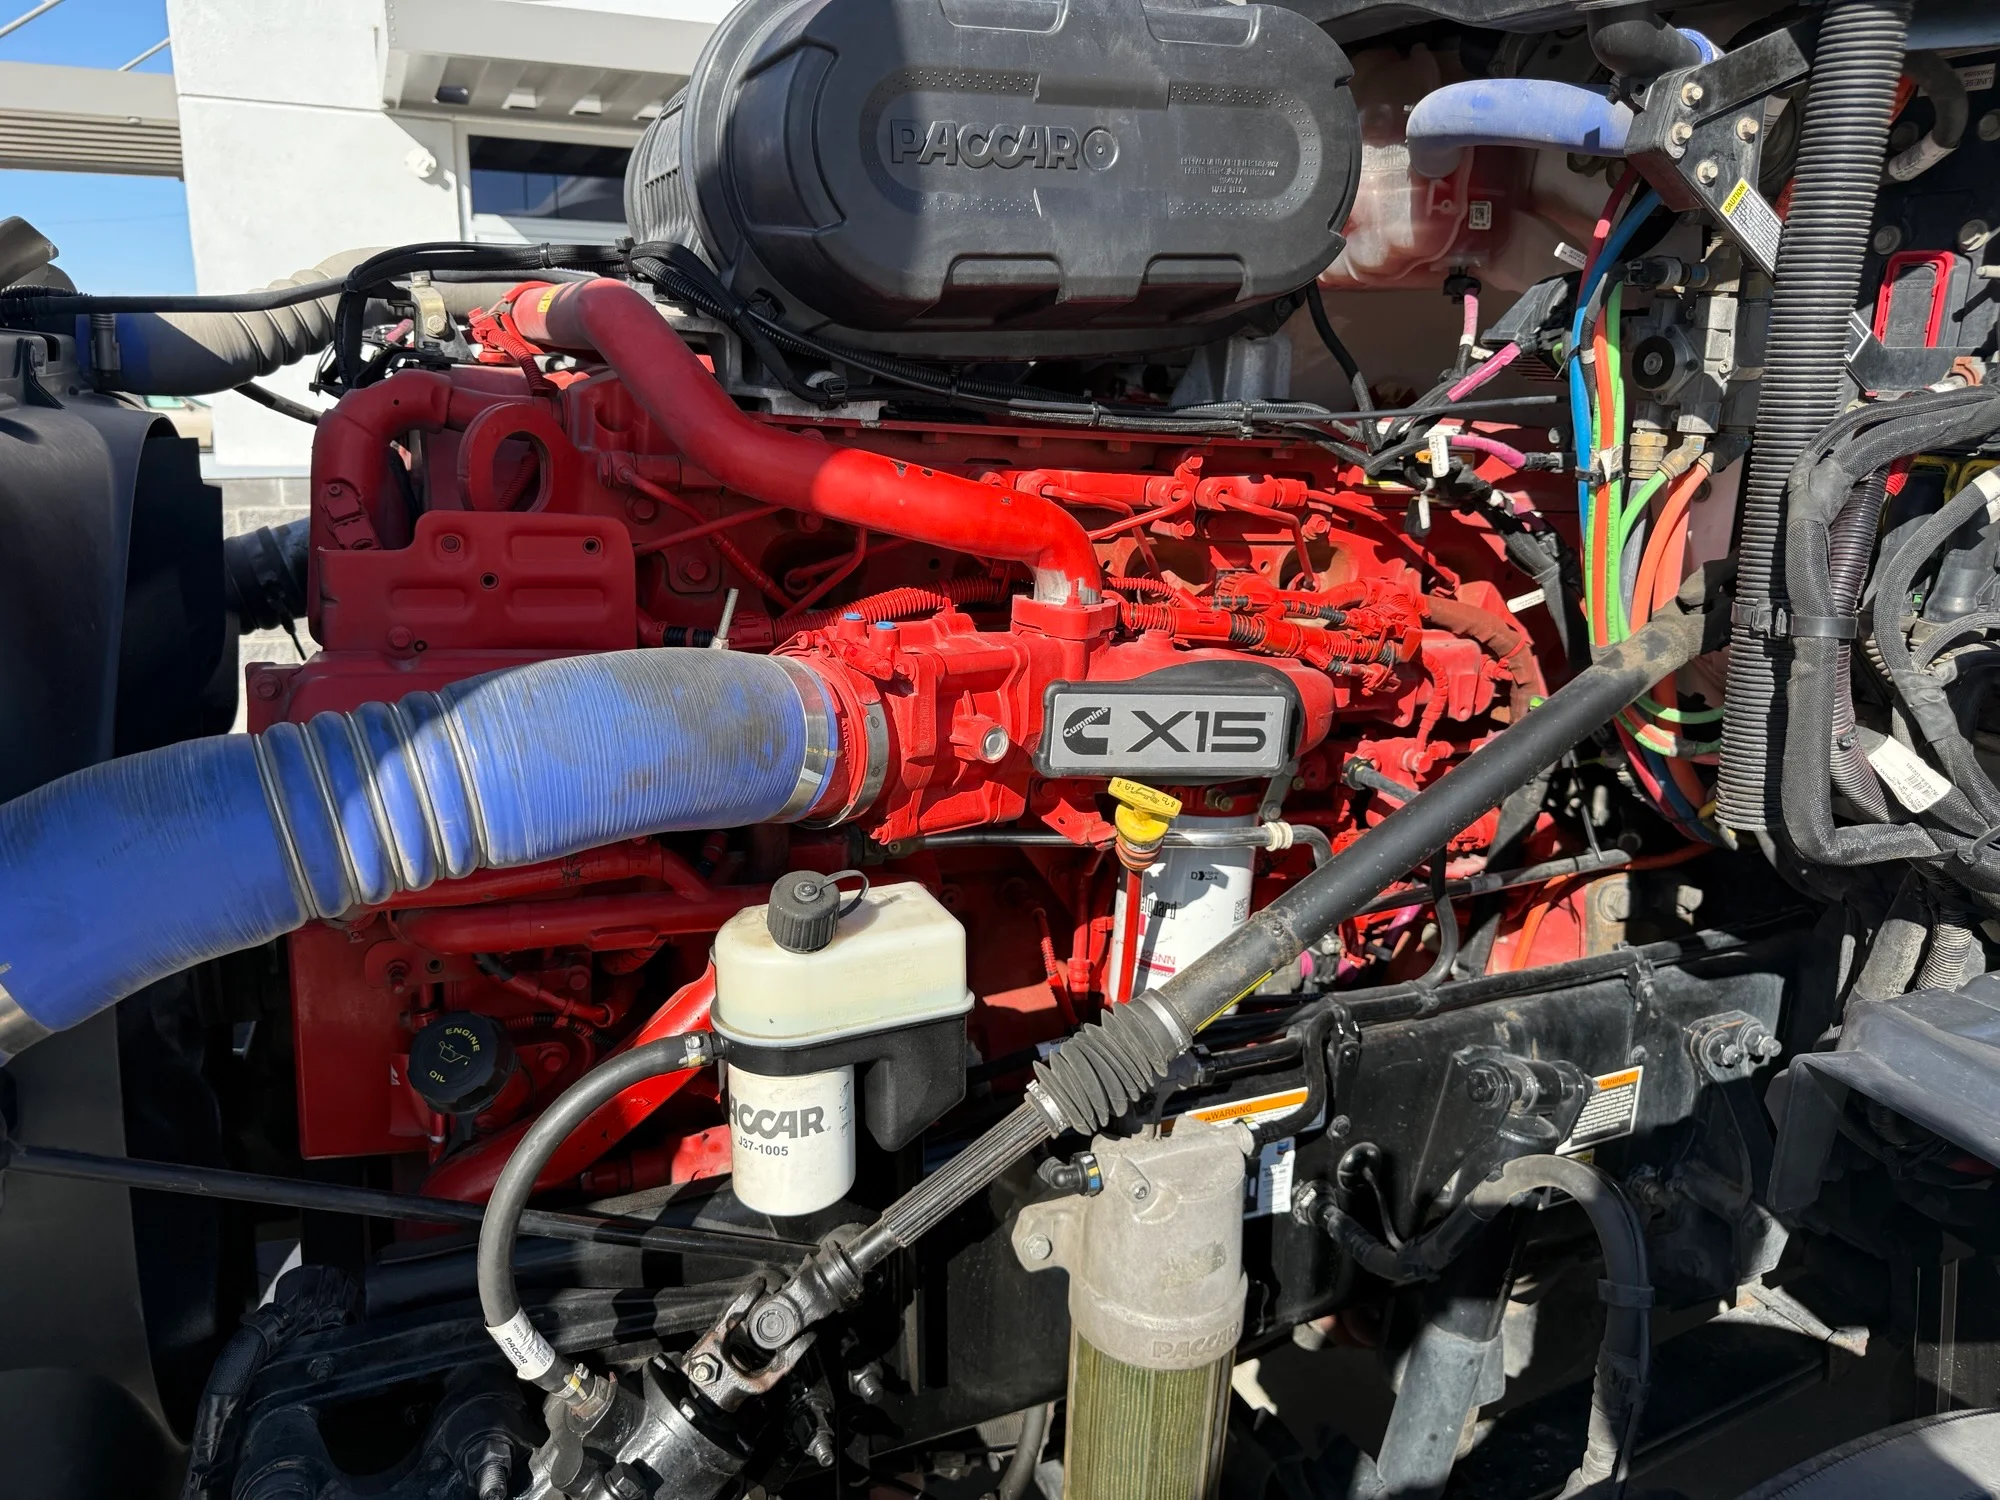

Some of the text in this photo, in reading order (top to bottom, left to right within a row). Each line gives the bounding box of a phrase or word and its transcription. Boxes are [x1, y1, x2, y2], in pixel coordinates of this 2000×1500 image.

[890, 119, 1079, 170] PACCAR
[1724, 183, 1746, 213] CAUTION
[1063, 706, 1109, 738] Cummins
[1125, 710, 1267, 752] X15
[445, 1027, 480, 1052] ENGINE
[429, 1070, 446, 1083] OIL
[1600, 1074, 1627, 1088] ARNING
[730, 1092, 825, 1139] ACCAR
[1210, 1105, 1252, 1121] WARNING
[505, 1337, 528, 1364] PACCAR
[1153, 1320, 1240, 1358] PACCAR
